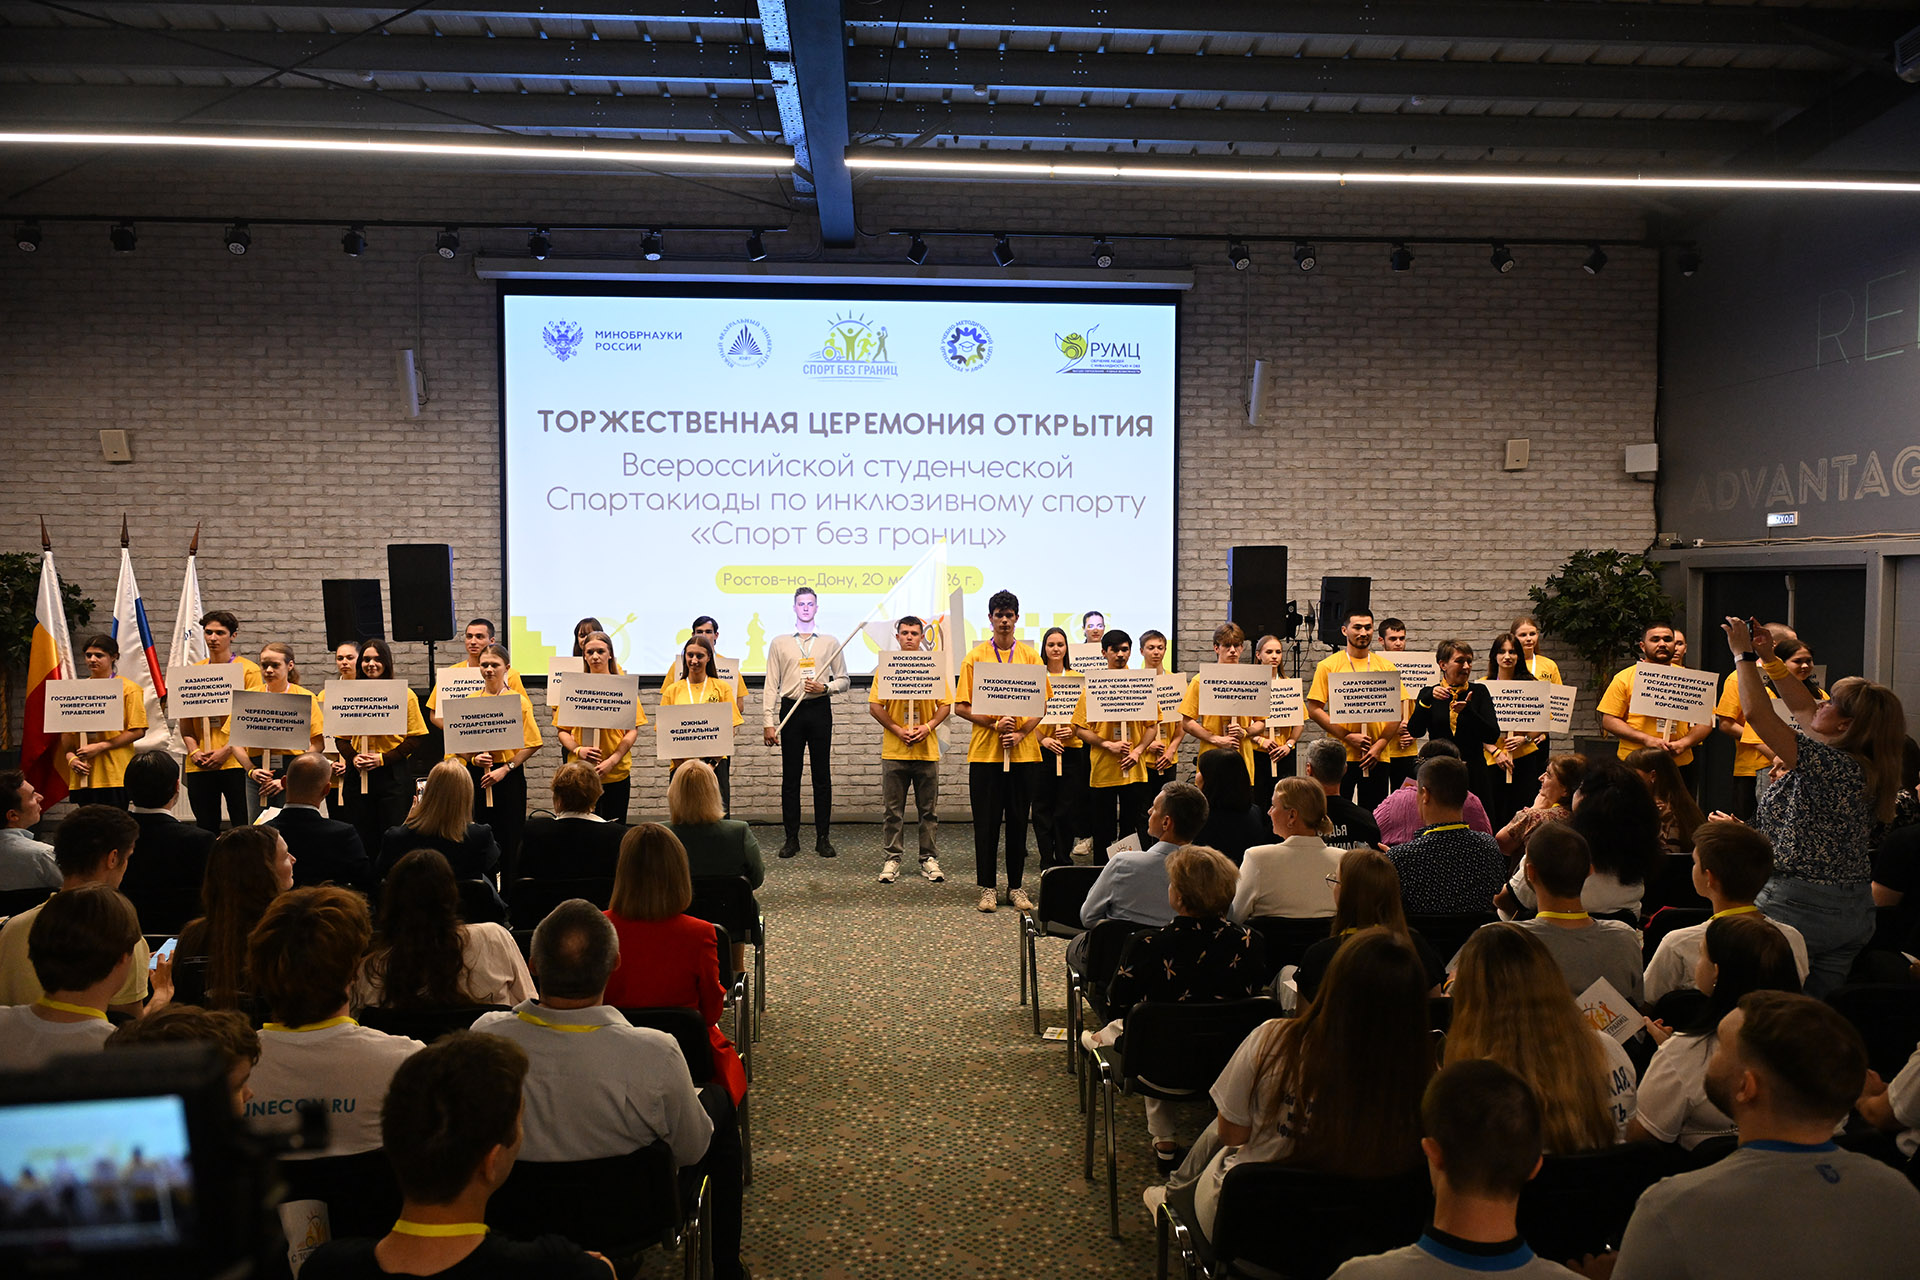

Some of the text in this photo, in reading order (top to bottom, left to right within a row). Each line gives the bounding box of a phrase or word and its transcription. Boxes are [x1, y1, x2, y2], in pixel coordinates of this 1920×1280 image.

[1816, 263, 1920, 371] RE
[595, 330, 683, 340] МИНОБРНАУКИ
[595, 342, 642, 351] РОССИИ
[1090, 342, 1141, 360] РУМЦ
[803, 364, 898, 377] СПОРТ БЕЗ ГРАНИЦ
[537, 410, 1153, 438] ТОРЖЕСТВЕННАЯ ЦЕРЕМОНИЯ ОТКРЫТИЯ
[623, 452, 1073, 483] Всероссийской студенческой
[547, 486, 1146, 519] Спартакиады по инклюзивному спорту
[1769, 514, 1795, 524] ЫХОД
[691, 520, 1006, 550] «Спорт без границ»
[723, 572, 858, 588] Ростов-на-Дону,
[1644, 679, 1706, 692] ГОСУДАРСТВЕННАЯ
[575, 689, 623, 697] ЧЕЛЯБИНСКИЙ
[1647, 686, 1701, 698] КОНСЕРВАТОРИЯ
[566, 696, 631, 705] ГОСУДАРСТВЕННЫЙ
[1655, 701, 1688, 710] КОРСАКОВ
[1669, 696, 1704, 706] РИМСКОГО-
[245, 709, 298, 717] ЧЕРЕПОВЕЦКИЙ
[461, 712, 503, 720] ТЮМЕНСКИЙ
[237, 716, 304, 724] ГОСУДАРСТВЕННЫЙ
[449, 719, 516, 728] ГОСУДАРСТВЕННЫЙ
